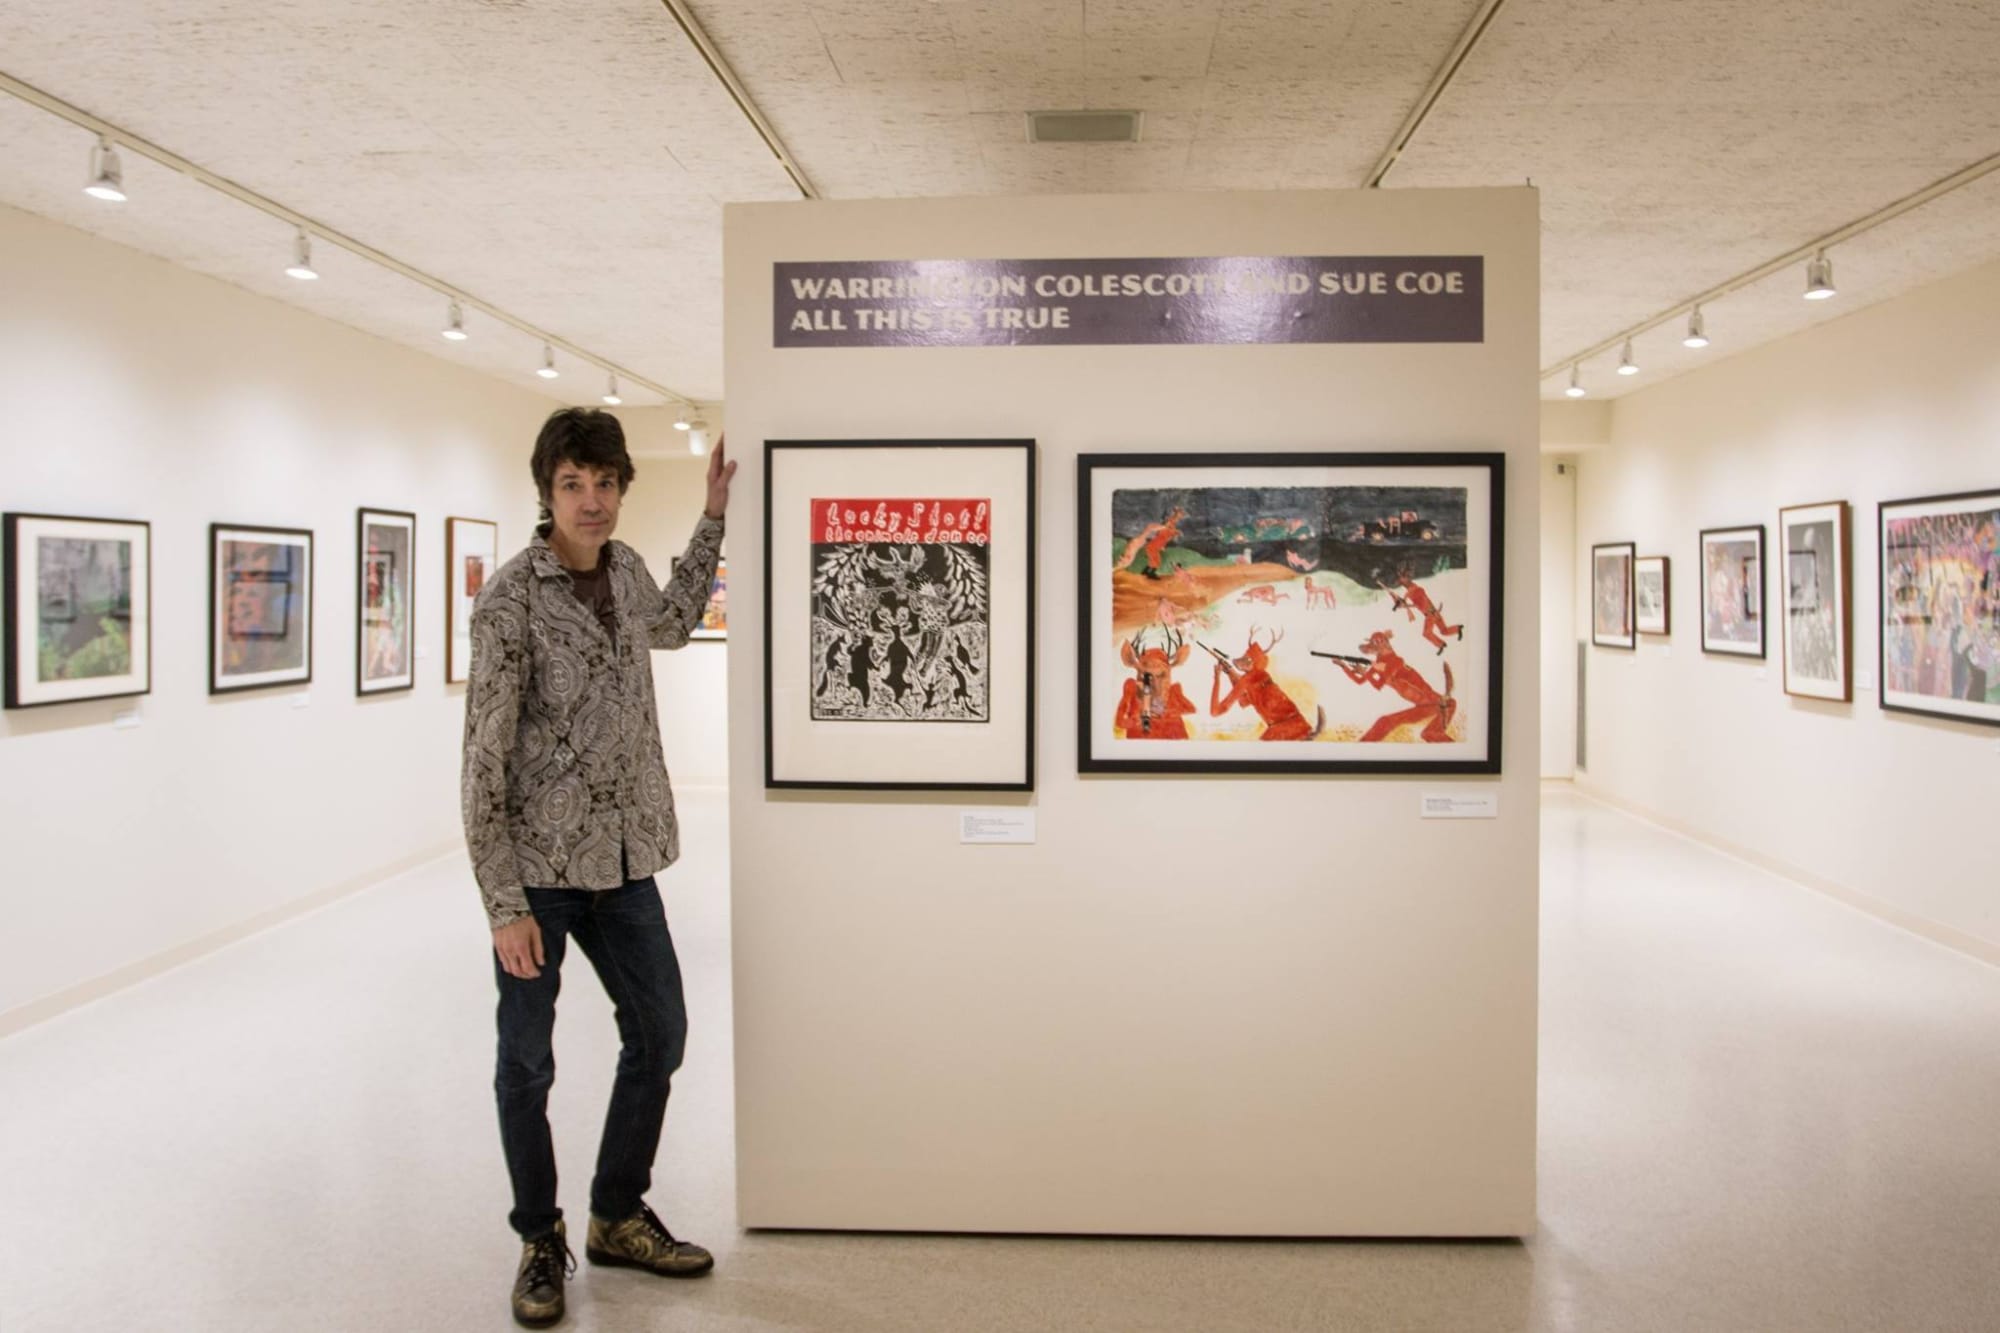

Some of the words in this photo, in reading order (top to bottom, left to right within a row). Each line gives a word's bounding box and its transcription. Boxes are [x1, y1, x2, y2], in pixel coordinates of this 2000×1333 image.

[1319, 271, 1387, 295] SUE
[1396, 271, 1464, 295] COE
[790, 309, 848, 331] ALL
[854, 308, 933, 331] THIS
[943, 307, 974, 330] IS
[985, 306, 1071, 330] TRUE
